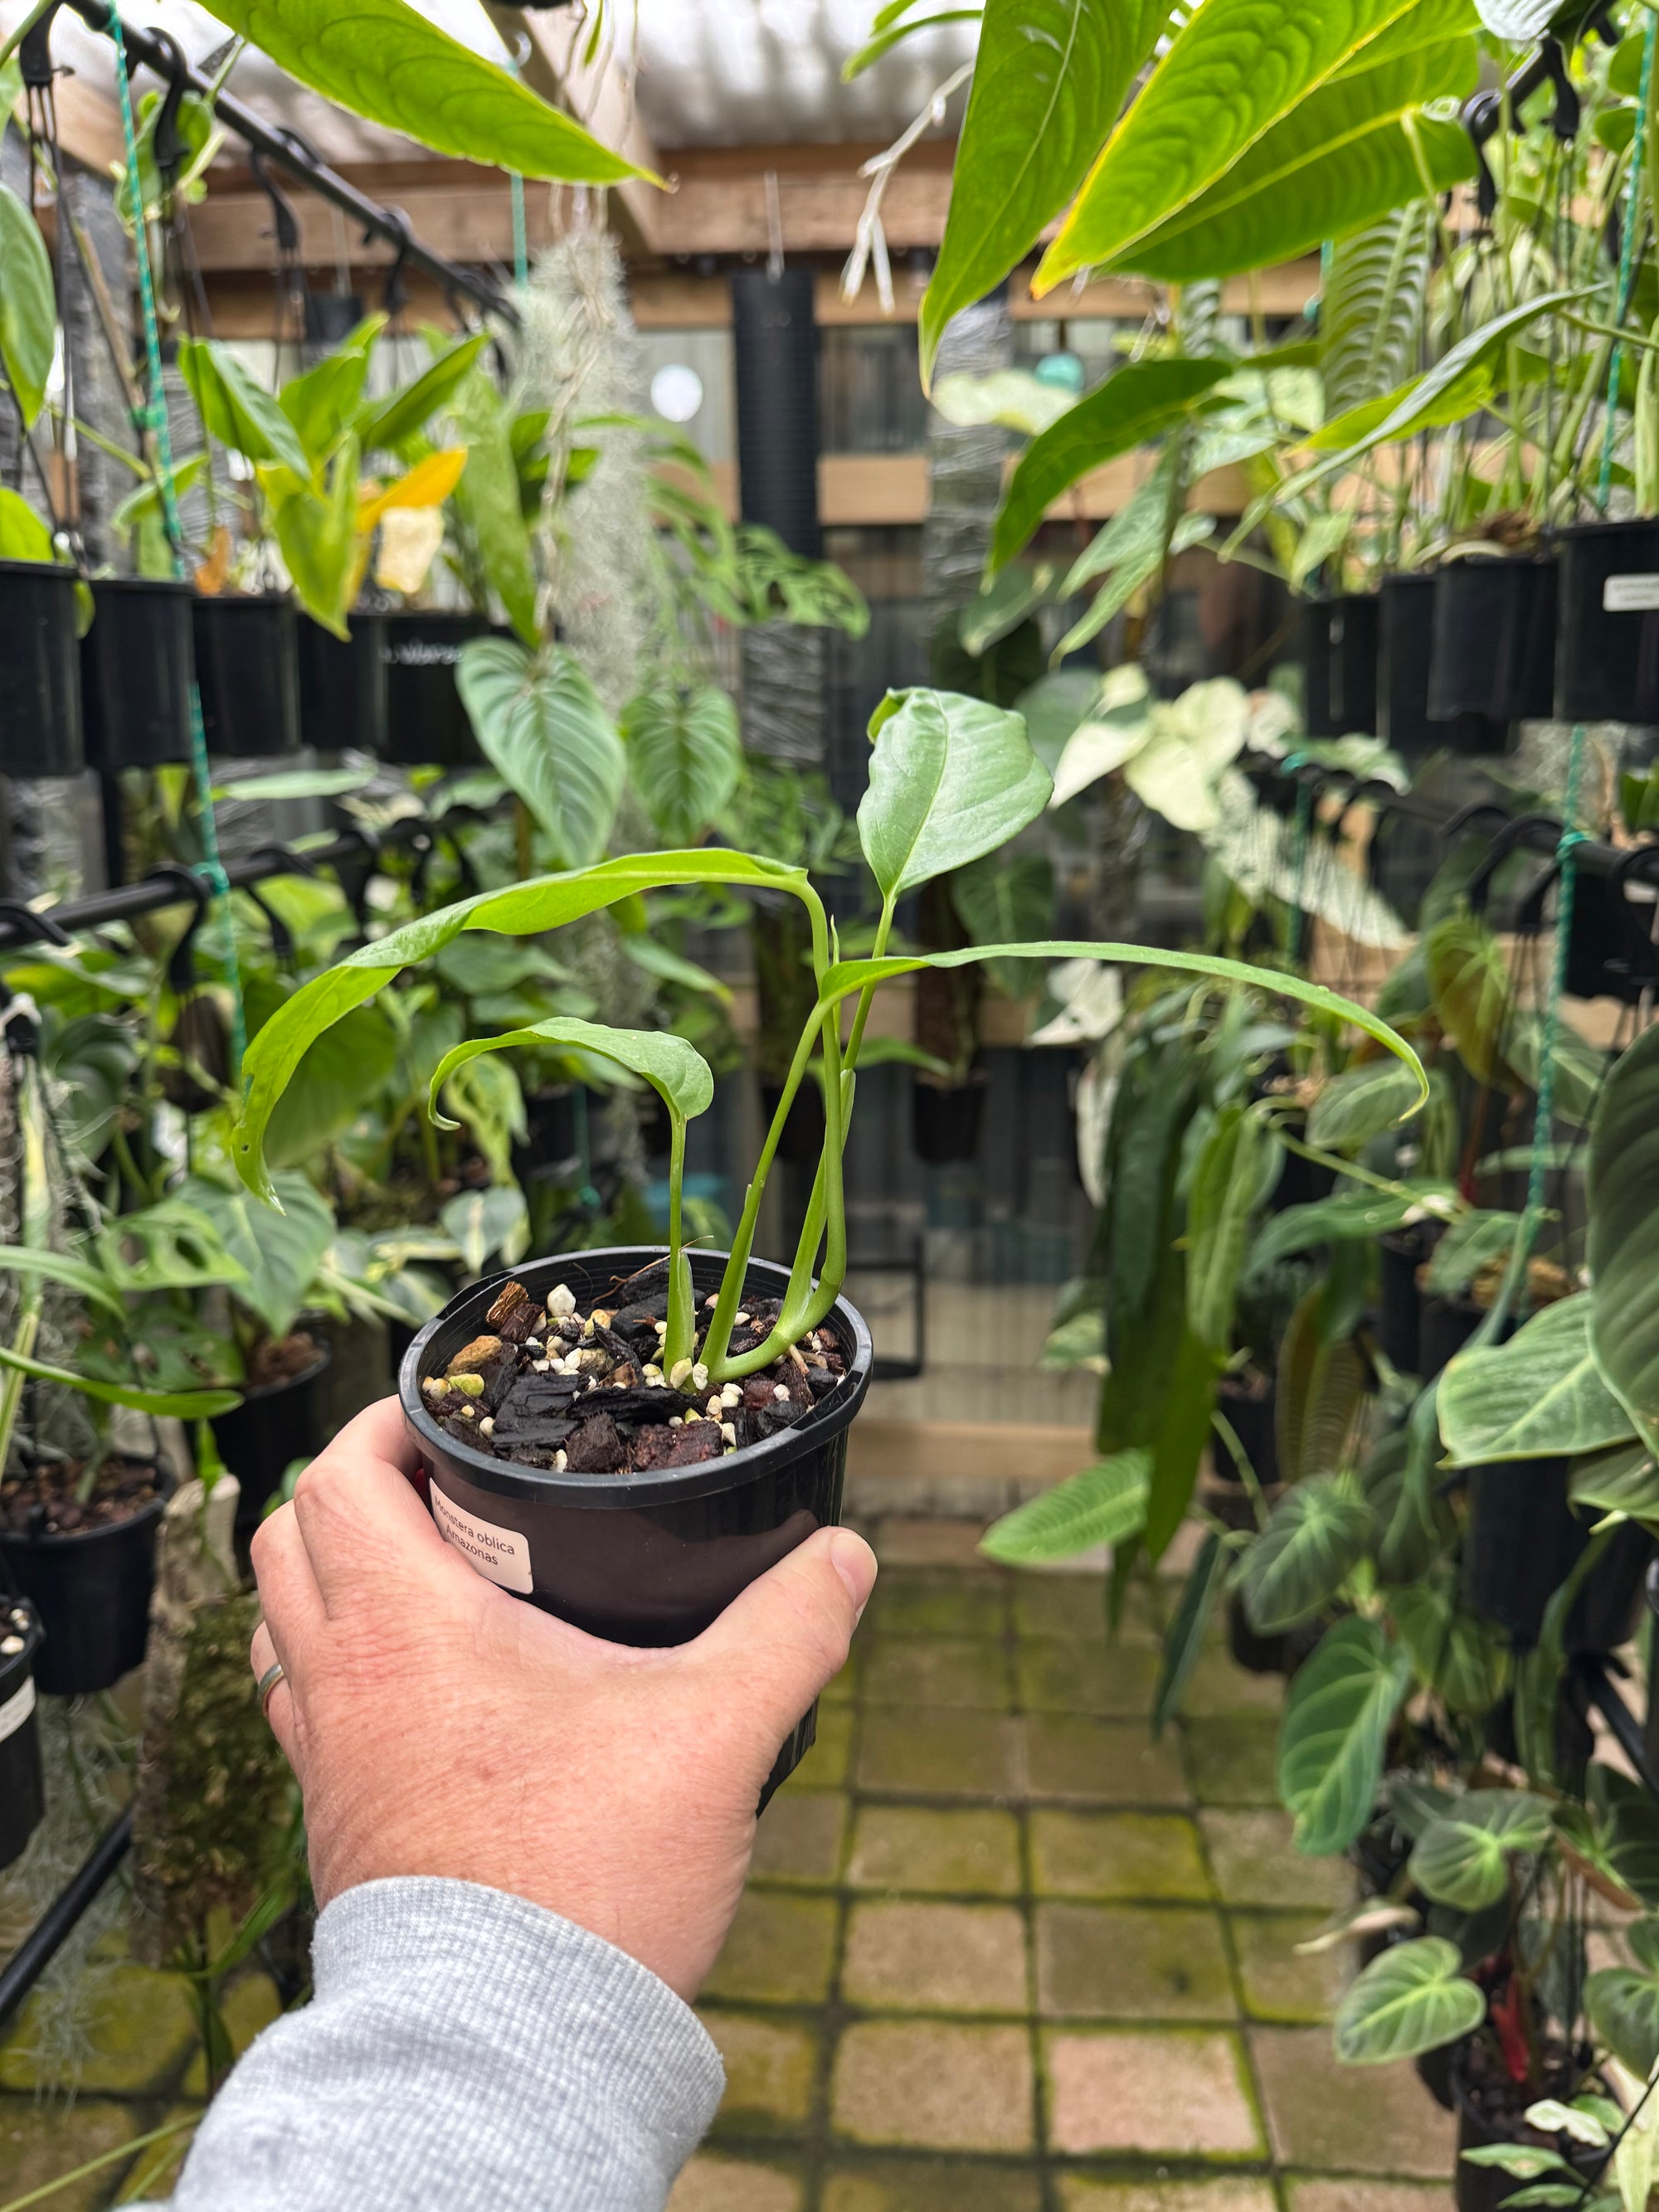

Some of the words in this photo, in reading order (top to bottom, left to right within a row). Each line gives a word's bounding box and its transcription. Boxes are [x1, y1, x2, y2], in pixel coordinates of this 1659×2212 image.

[435, 1495, 474, 1538] Monstera
[477, 1533, 515, 1555] oblica
[446, 1524, 499, 1565] Amazonas
